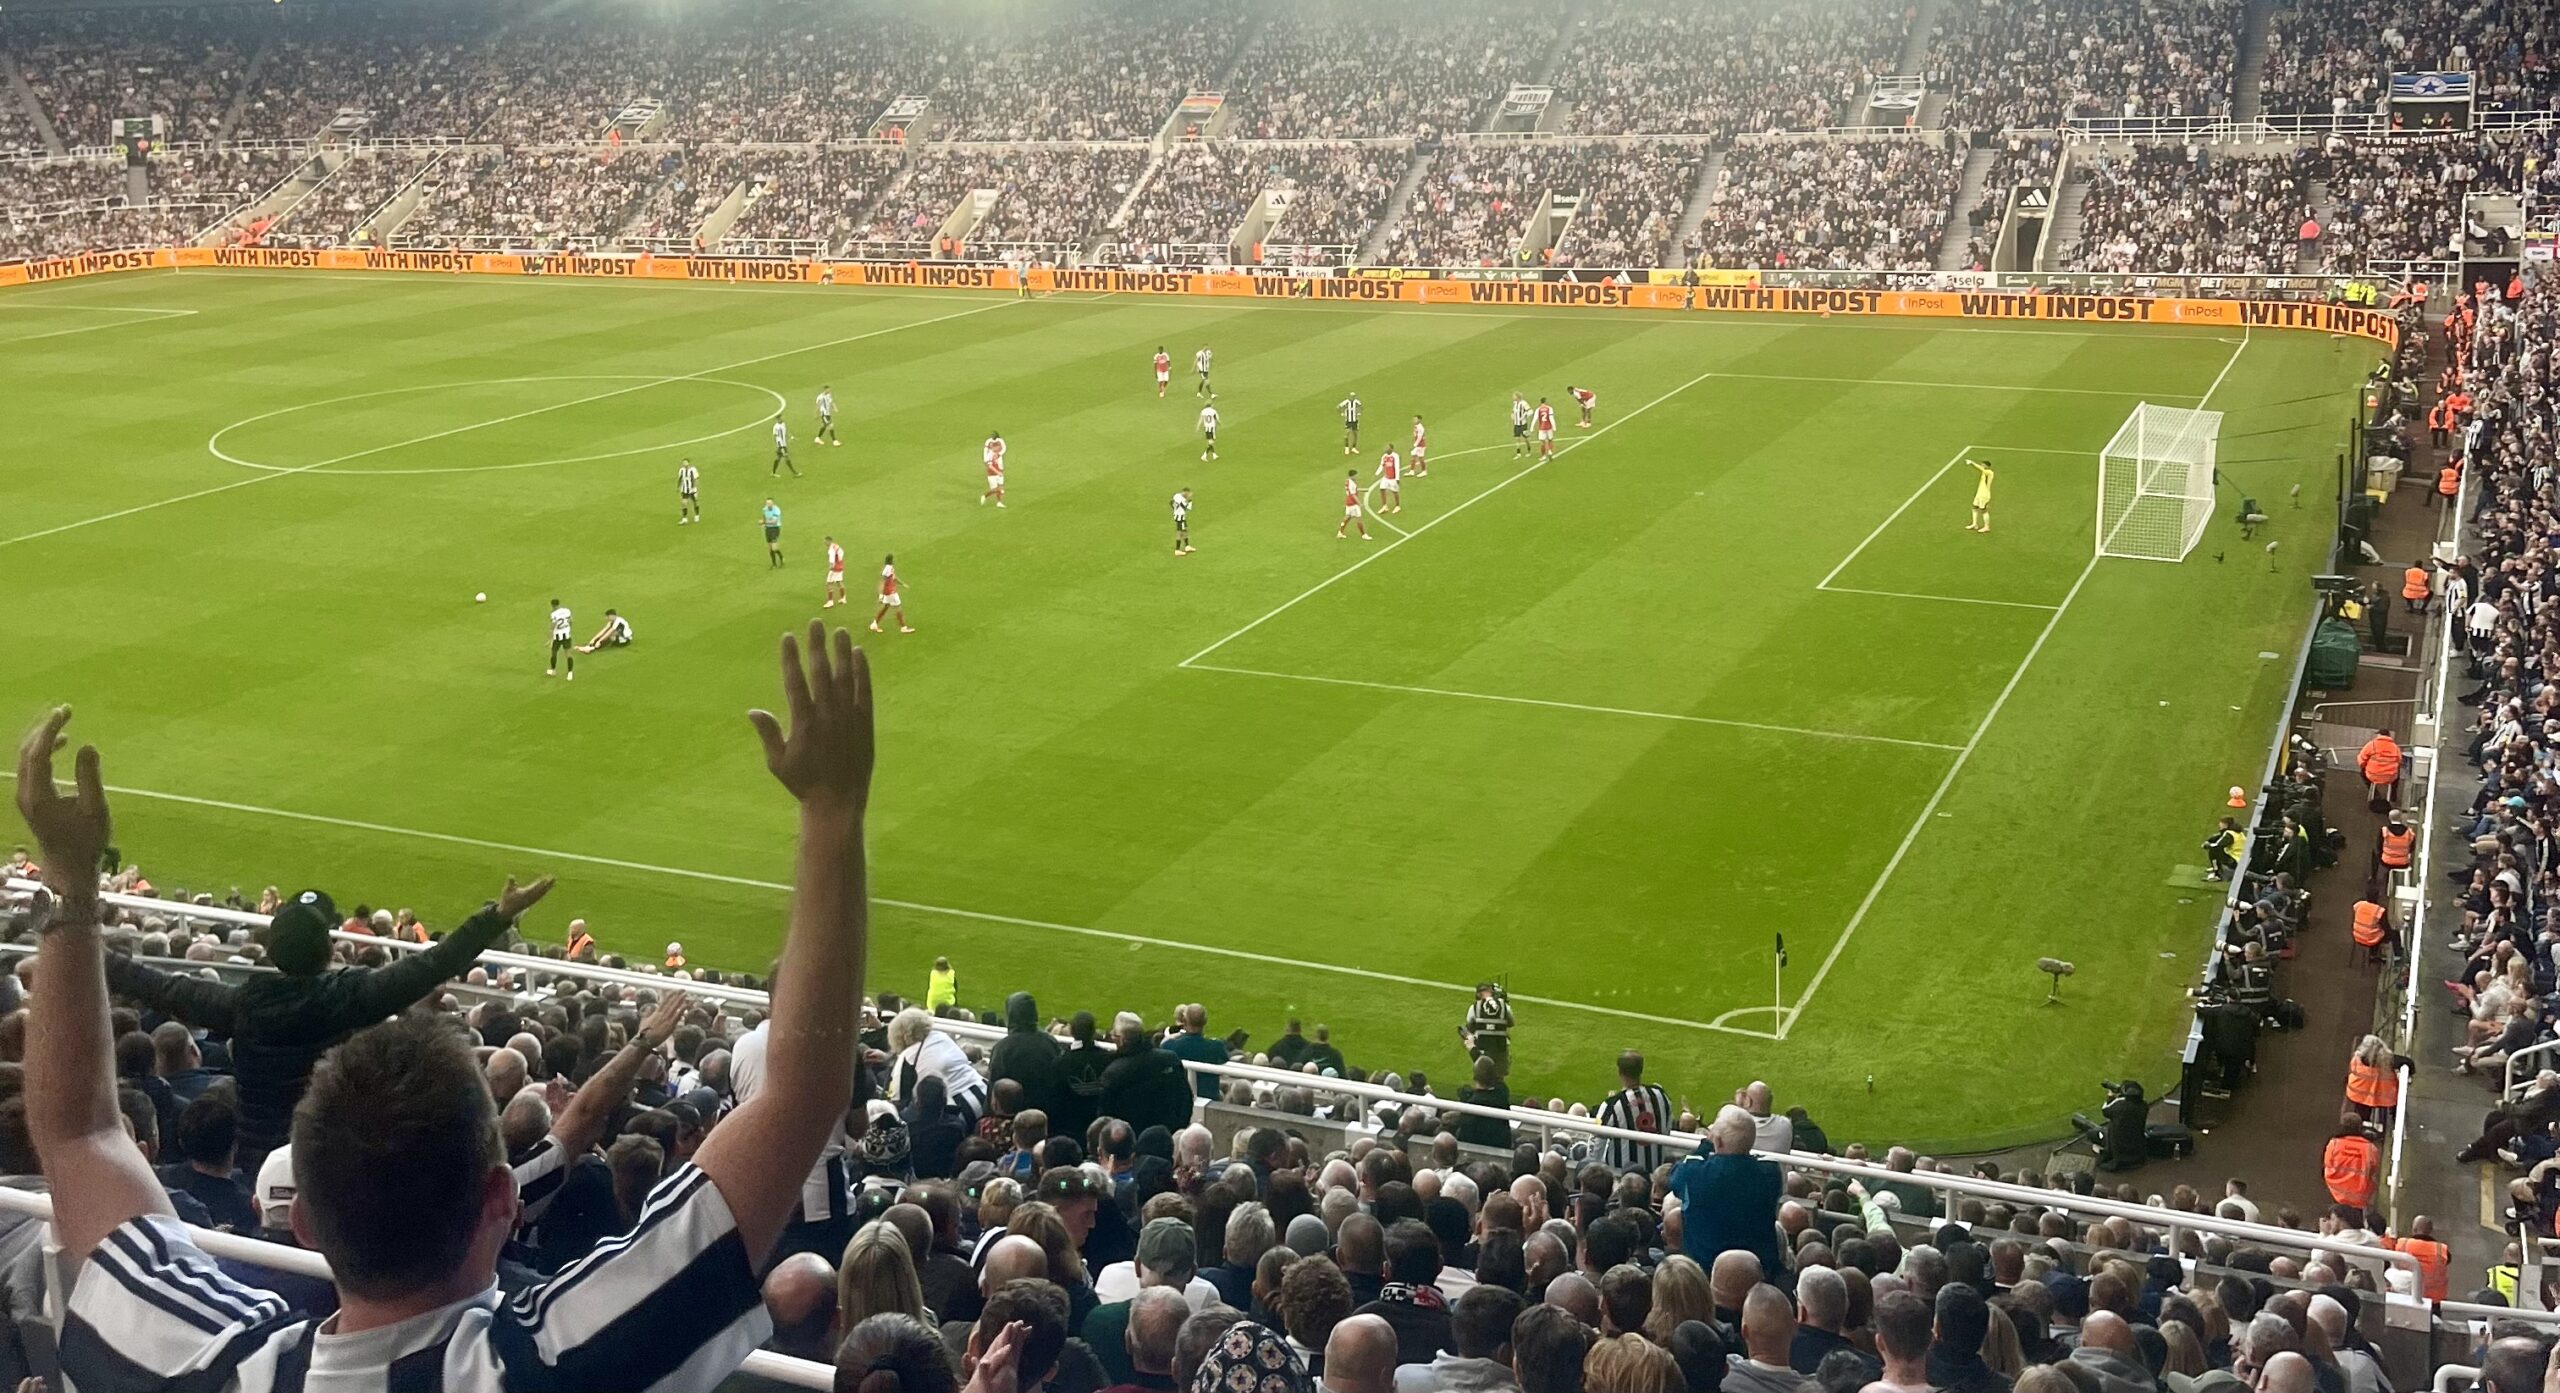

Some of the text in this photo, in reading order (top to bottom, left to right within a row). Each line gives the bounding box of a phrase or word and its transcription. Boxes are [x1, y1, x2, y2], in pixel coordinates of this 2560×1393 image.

[2384, 136, 2408, 145] THE
[2453, 130, 2477, 140] THE
[26, 259, 75, 280] WITH
[80, 251, 155, 273] INPOST
[214, 249, 320, 267] WITH INPOST
[365, 252, 473, 270] WITH INPOST
[521, 256, 636, 275] WTH INPOST
[687, 260, 811, 281] WITH INPOST
[864, 265, 995, 286] WITH INPOST
[1053, 271, 1193, 292] WITH INPOST
[1321, 279, 1405, 299] INPOST
[1427, 286, 1457, 296] InPost
[1959, 276, 1985, 287] sela
[2265, 278, 2317, 289] BETMGM
[1470, 283, 1633, 306] WITH INPOST
[1705, 288, 1882, 312] WITH INPOST
[1908, 298, 1944, 309] InPost
[1961, 294, 2155, 320] WITH INPOST
[2184, 305, 2223, 317] InPost
[2239, 302, 2394, 342] WITH INPOST
